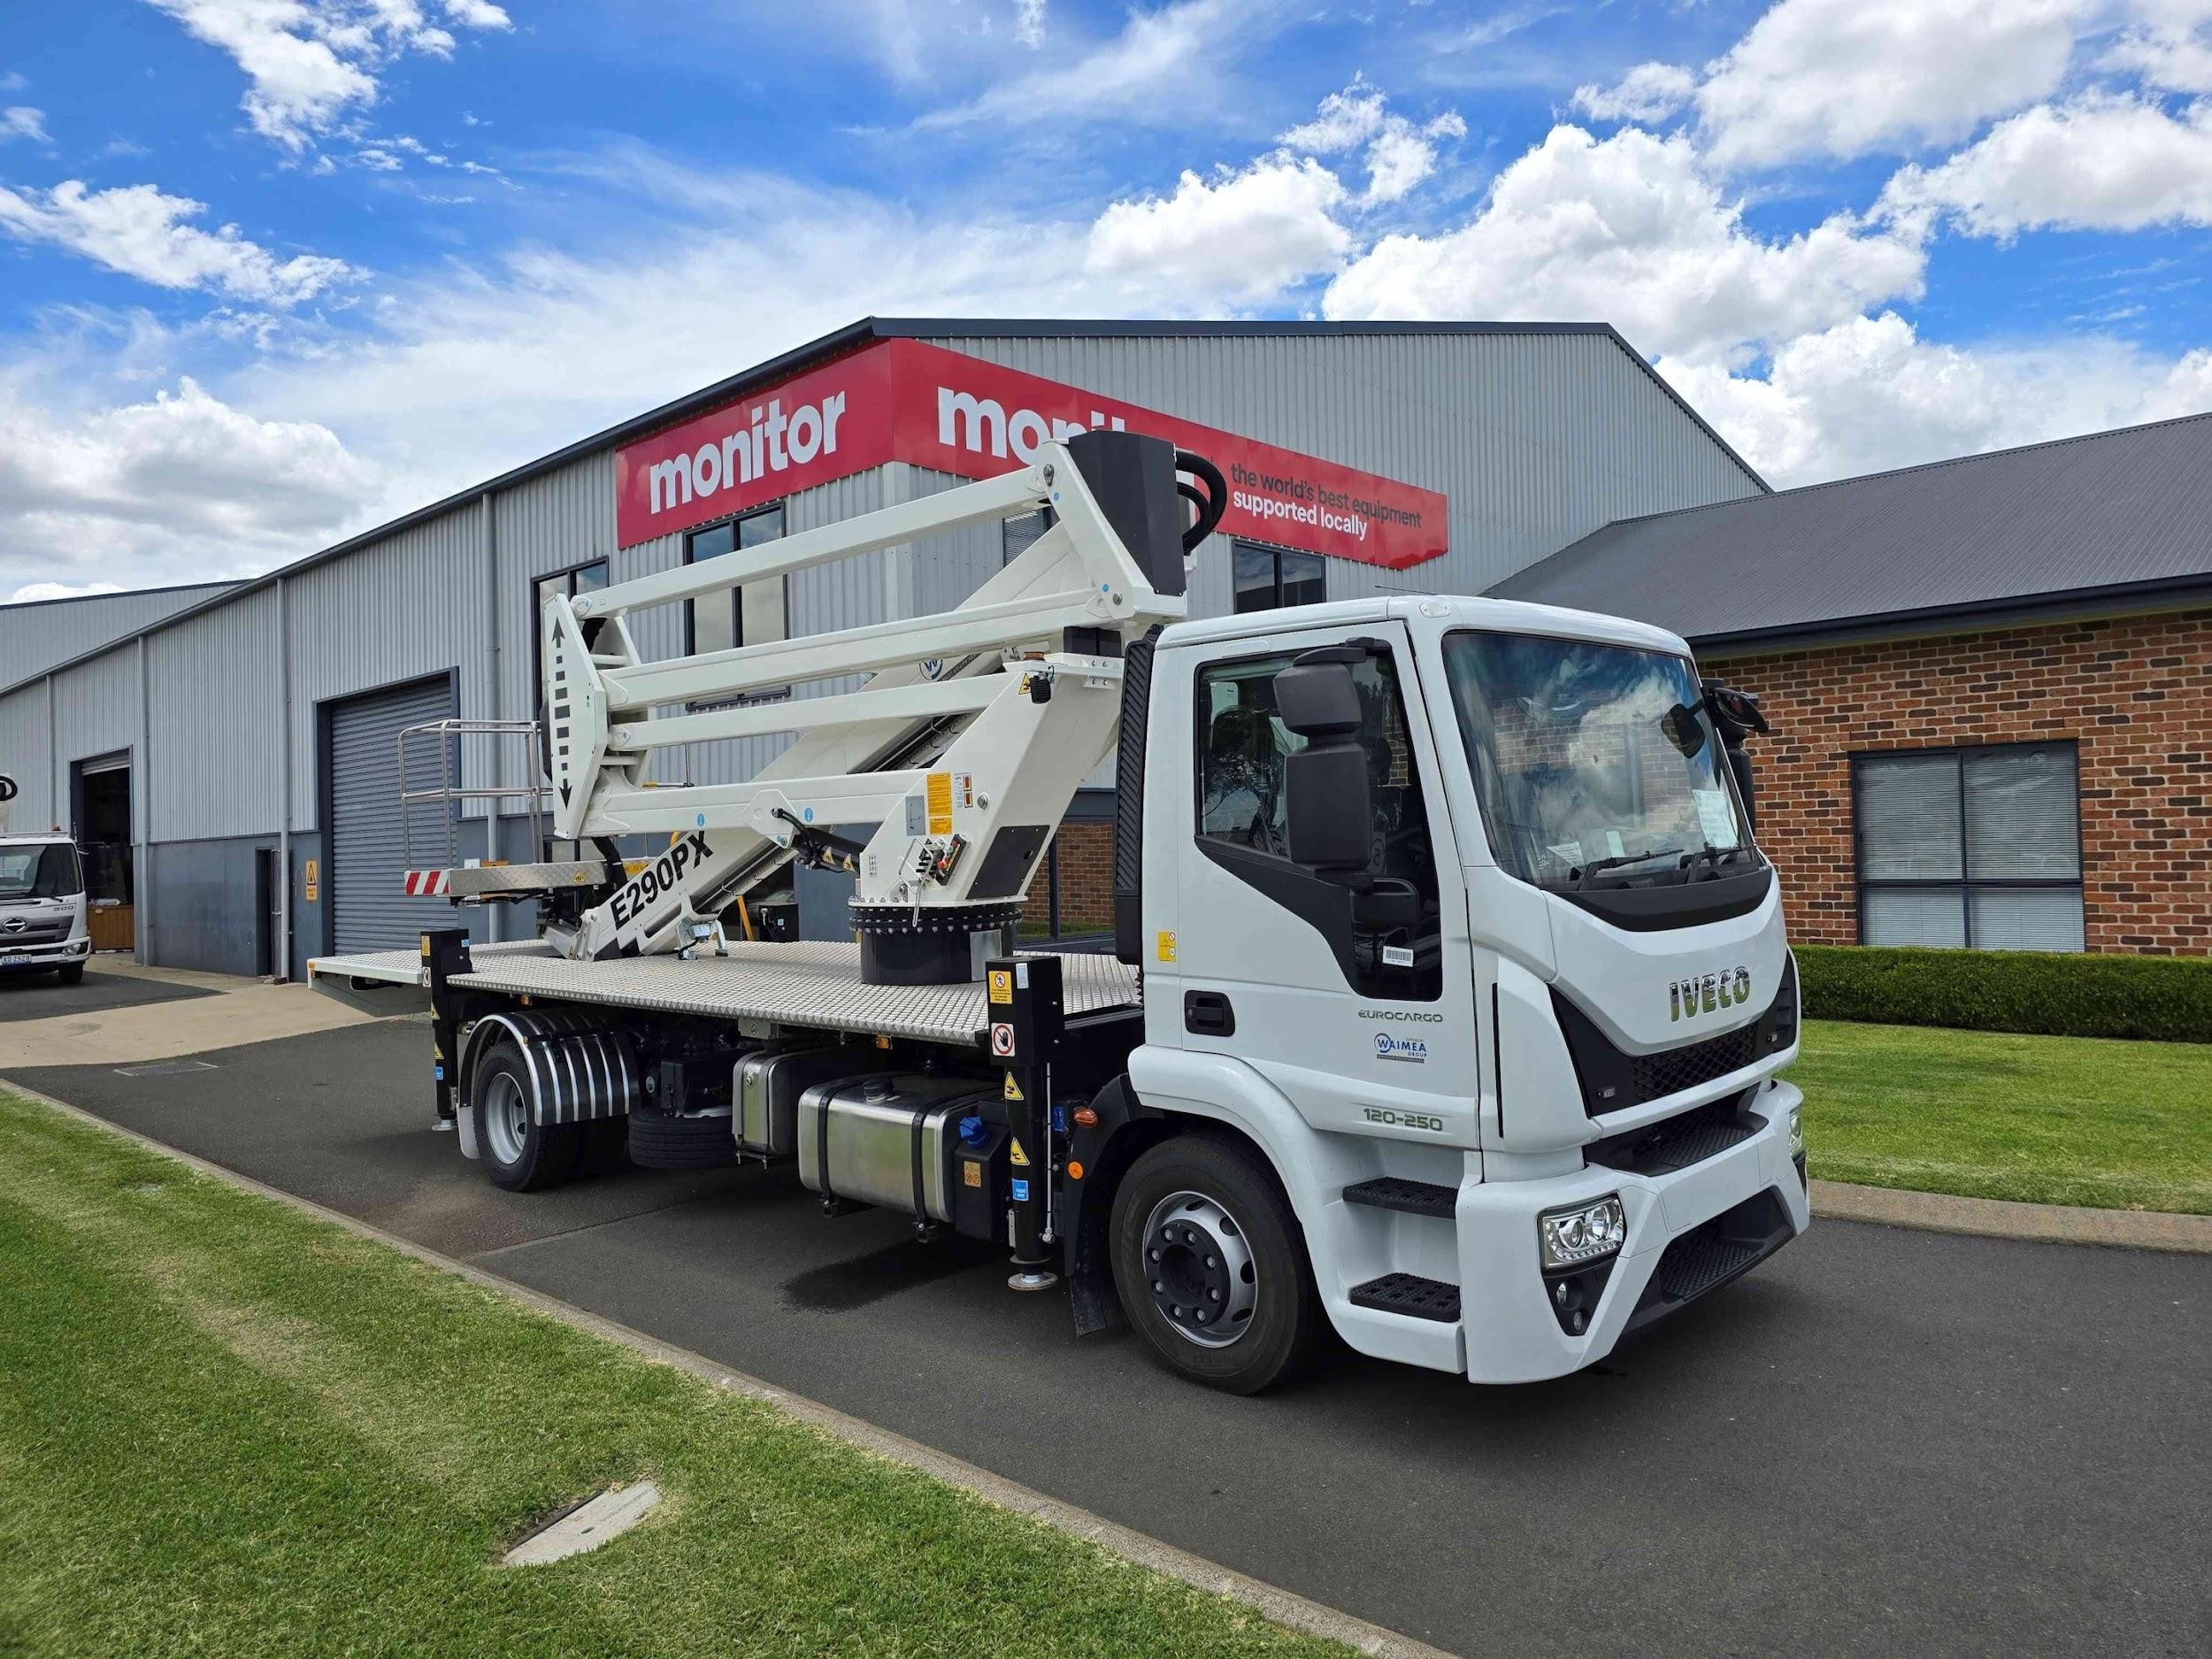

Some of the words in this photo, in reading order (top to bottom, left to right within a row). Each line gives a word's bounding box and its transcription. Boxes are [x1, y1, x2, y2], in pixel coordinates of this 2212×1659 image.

[649, 390, 846, 515] monitor
[1231, 463, 1257, 487] the
[1261, 473, 1315, 502] world's
[1318, 485, 1349, 511] best
[1352, 498, 1423, 528] equipment
[1233, 490, 1317, 526] supported
[1321, 508, 1368, 541] locally
[611, 831, 713, 931] E290PX
[1358, 1009, 1443, 1023] EUROCARGO
[1670, 966, 1750, 1023] IVECO
[1377, 1038, 1426, 1052] WAIMEA
[1363, 1107, 1443, 1132] 120-250
